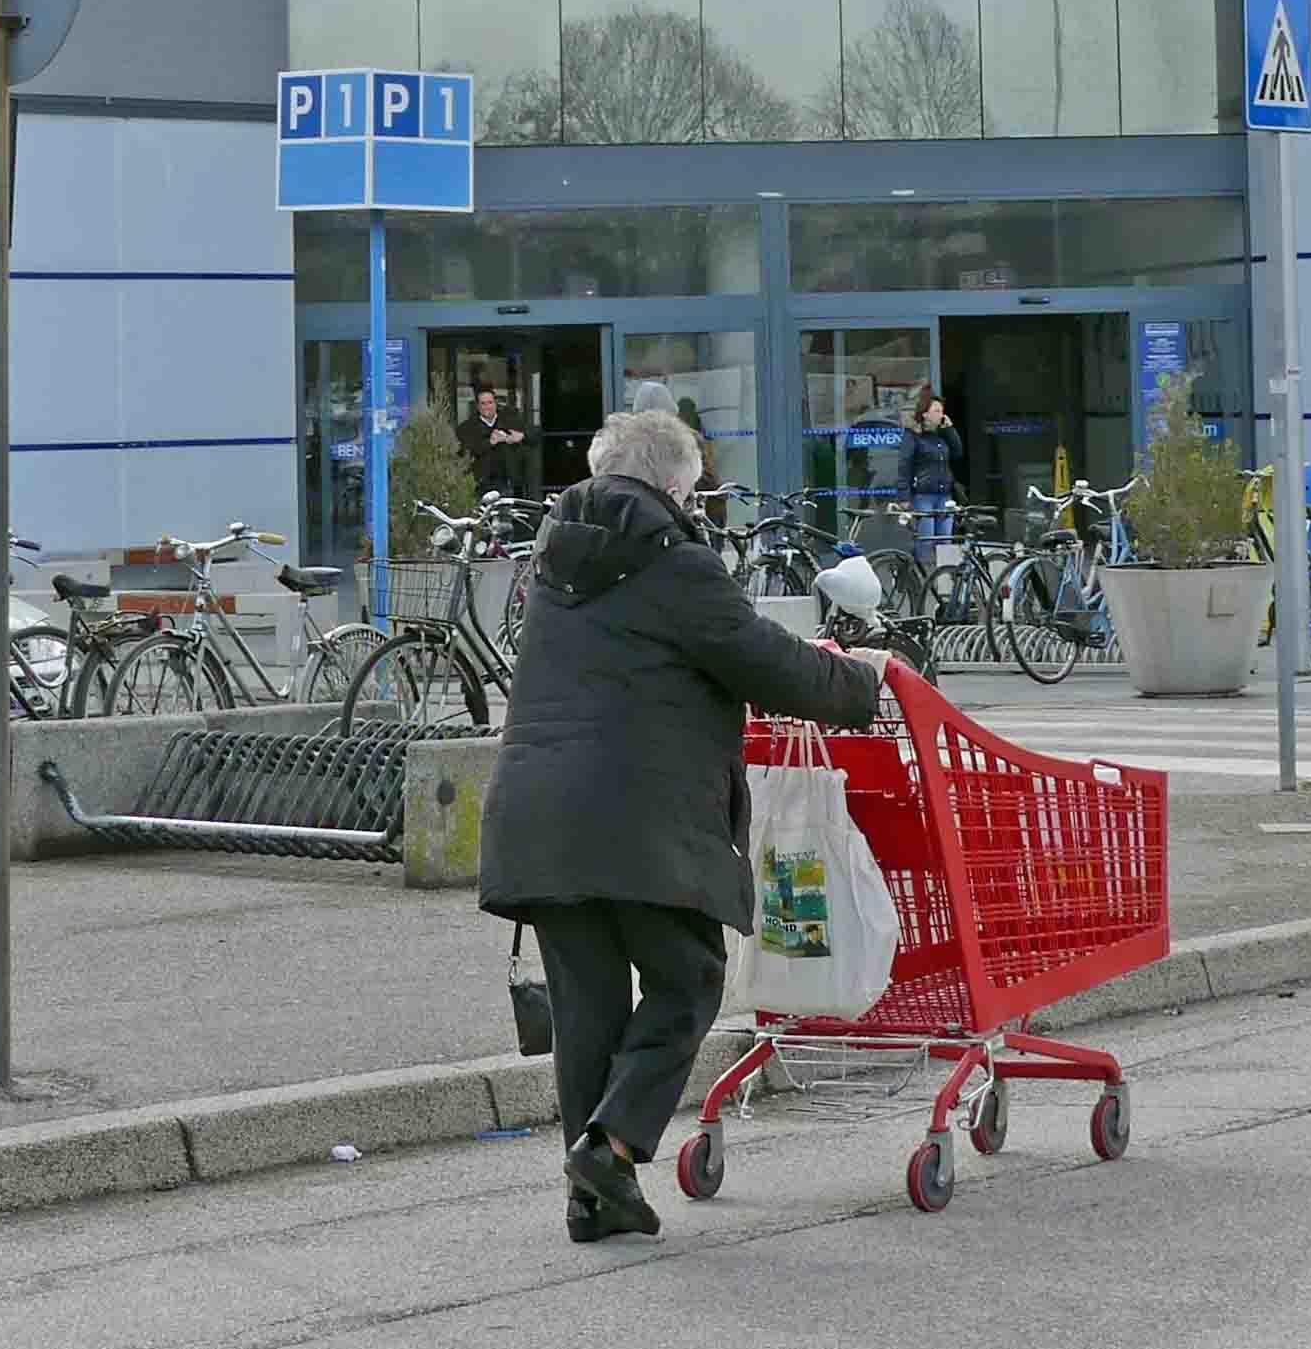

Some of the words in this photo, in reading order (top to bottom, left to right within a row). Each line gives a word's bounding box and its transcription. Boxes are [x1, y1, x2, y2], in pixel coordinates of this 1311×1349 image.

[289, 85, 313, 130] P
[339, 83, 353, 128] 1
[383, 83, 410, 128] P
[440, 87, 454, 131] 1
